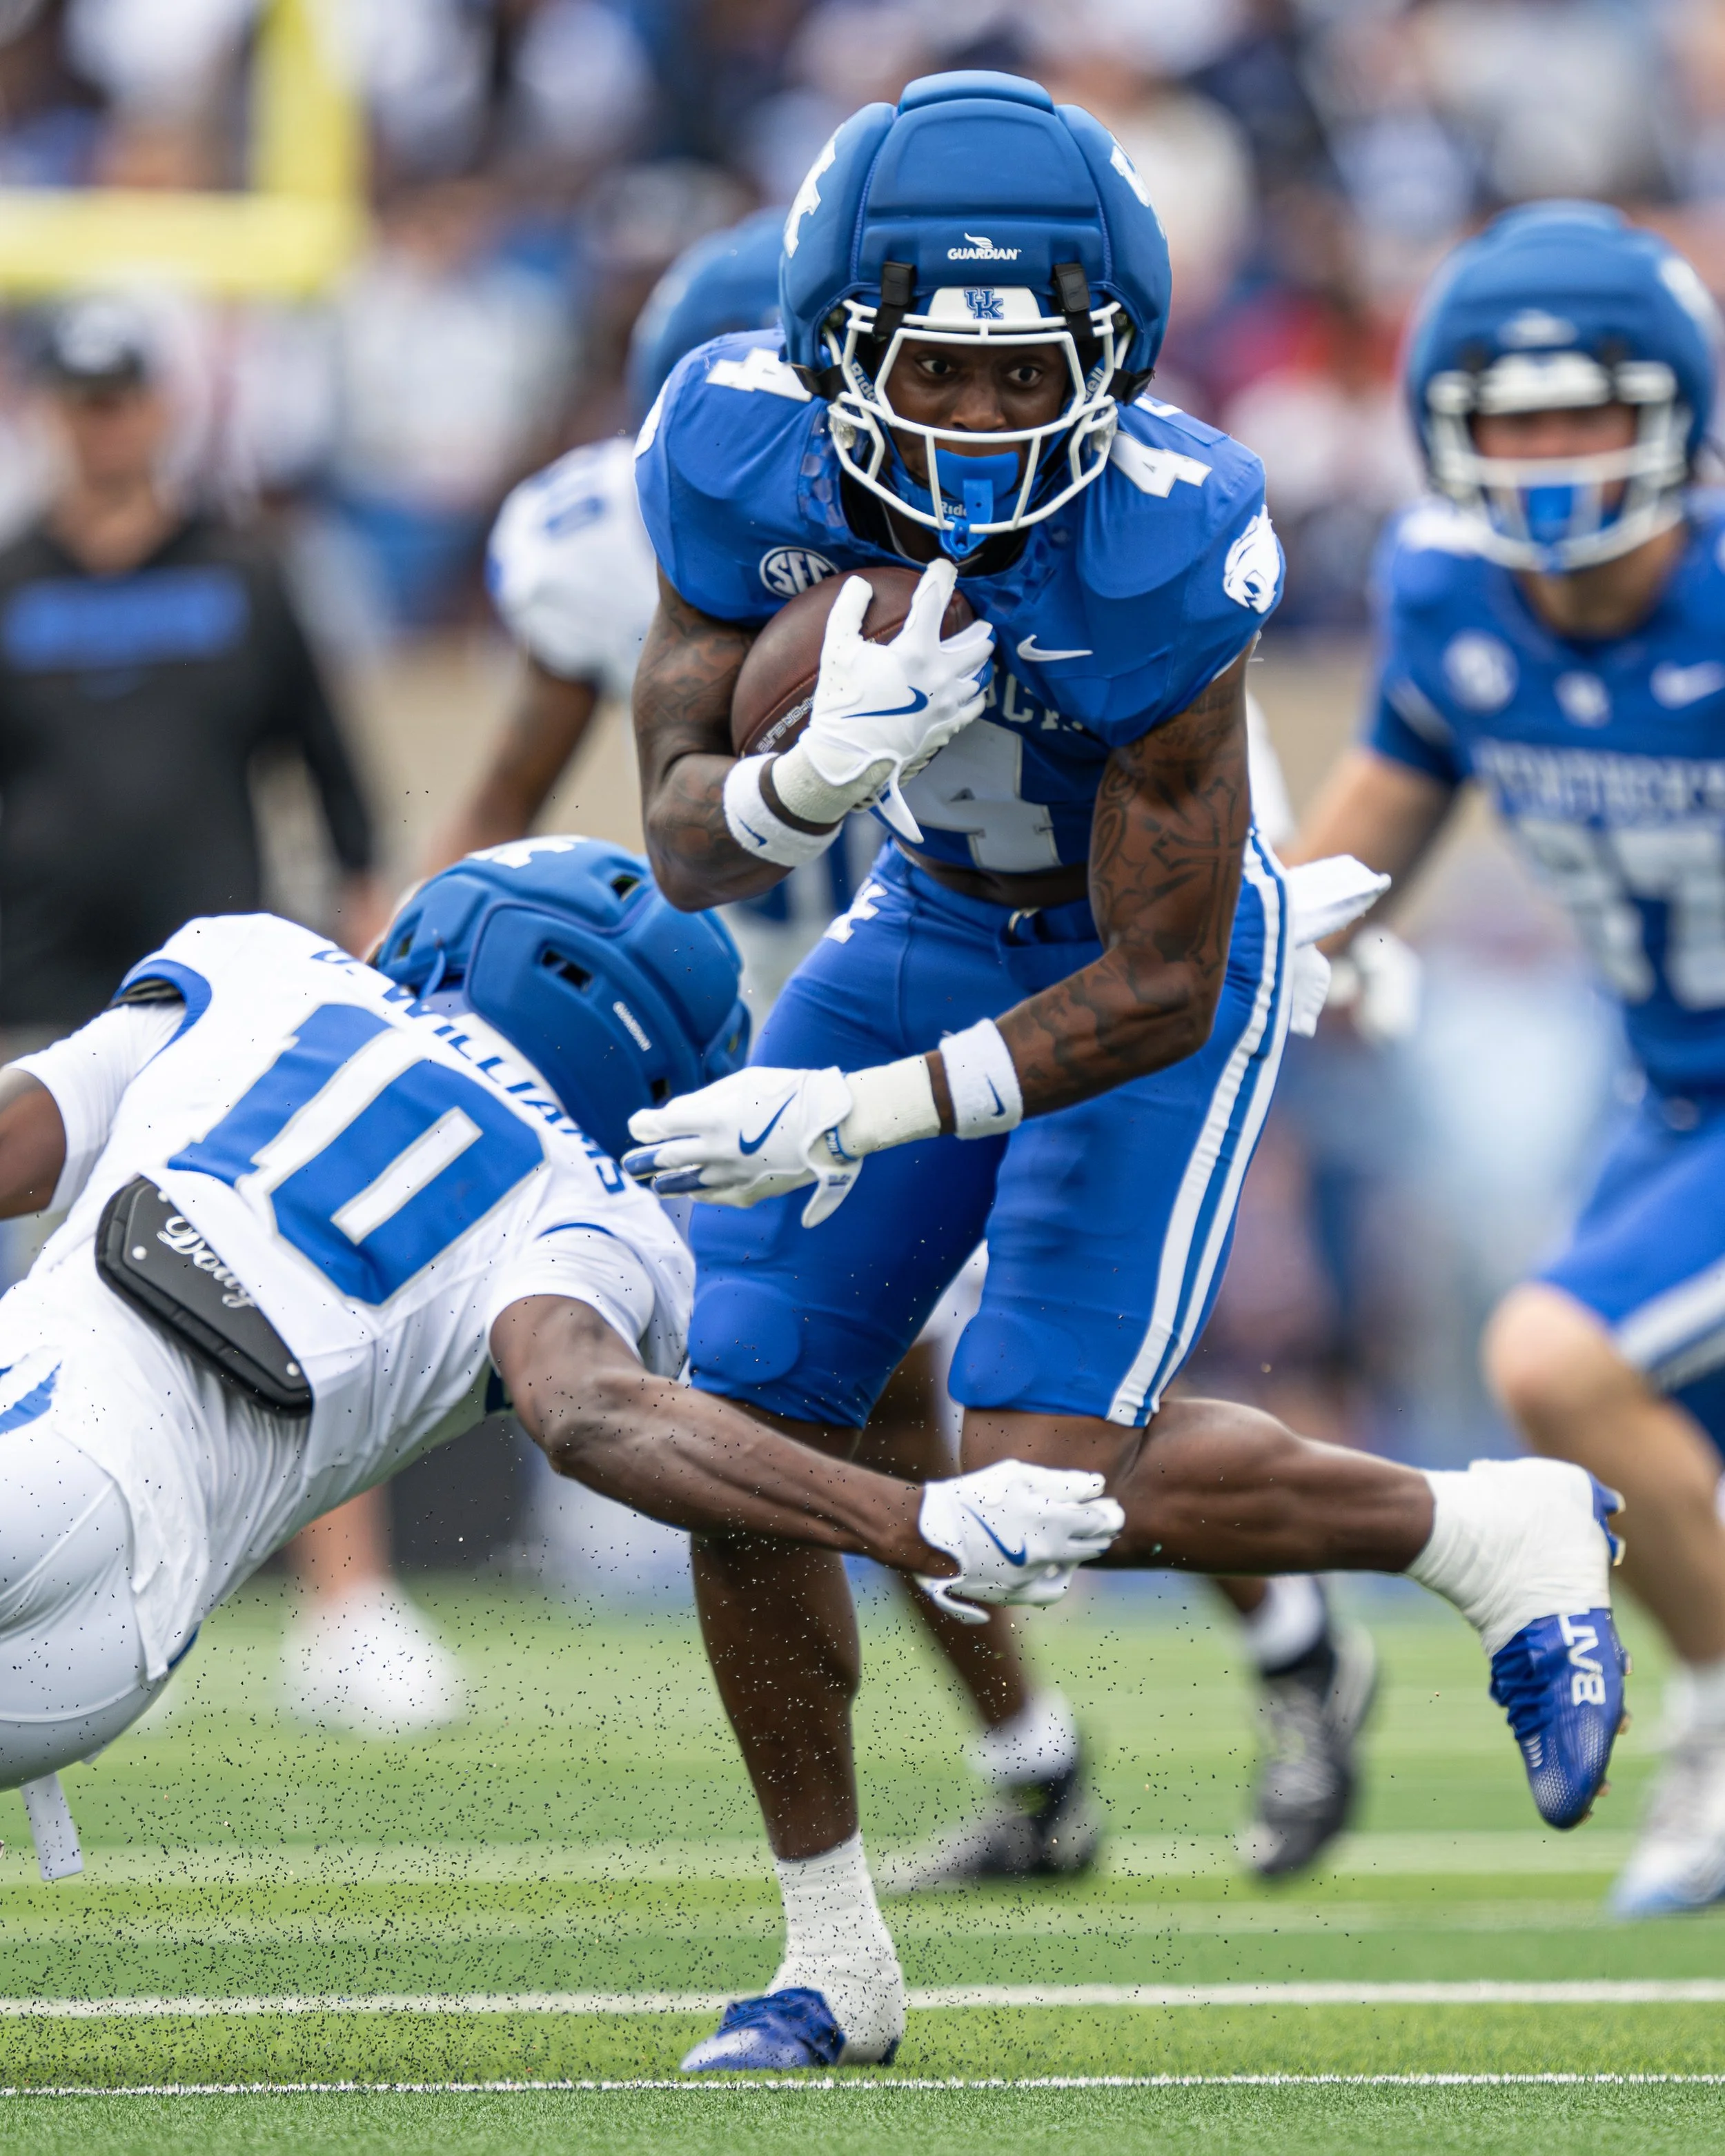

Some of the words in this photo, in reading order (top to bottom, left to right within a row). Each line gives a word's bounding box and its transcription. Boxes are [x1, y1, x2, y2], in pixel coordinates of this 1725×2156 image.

[947, 247, 1018, 261] GUARDIAN
[963, 288, 1004, 319] UK
[1109, 429, 1213, 499] 4
[903, 716, 1063, 873] 4
[167, 1002, 551, 1309] 10
